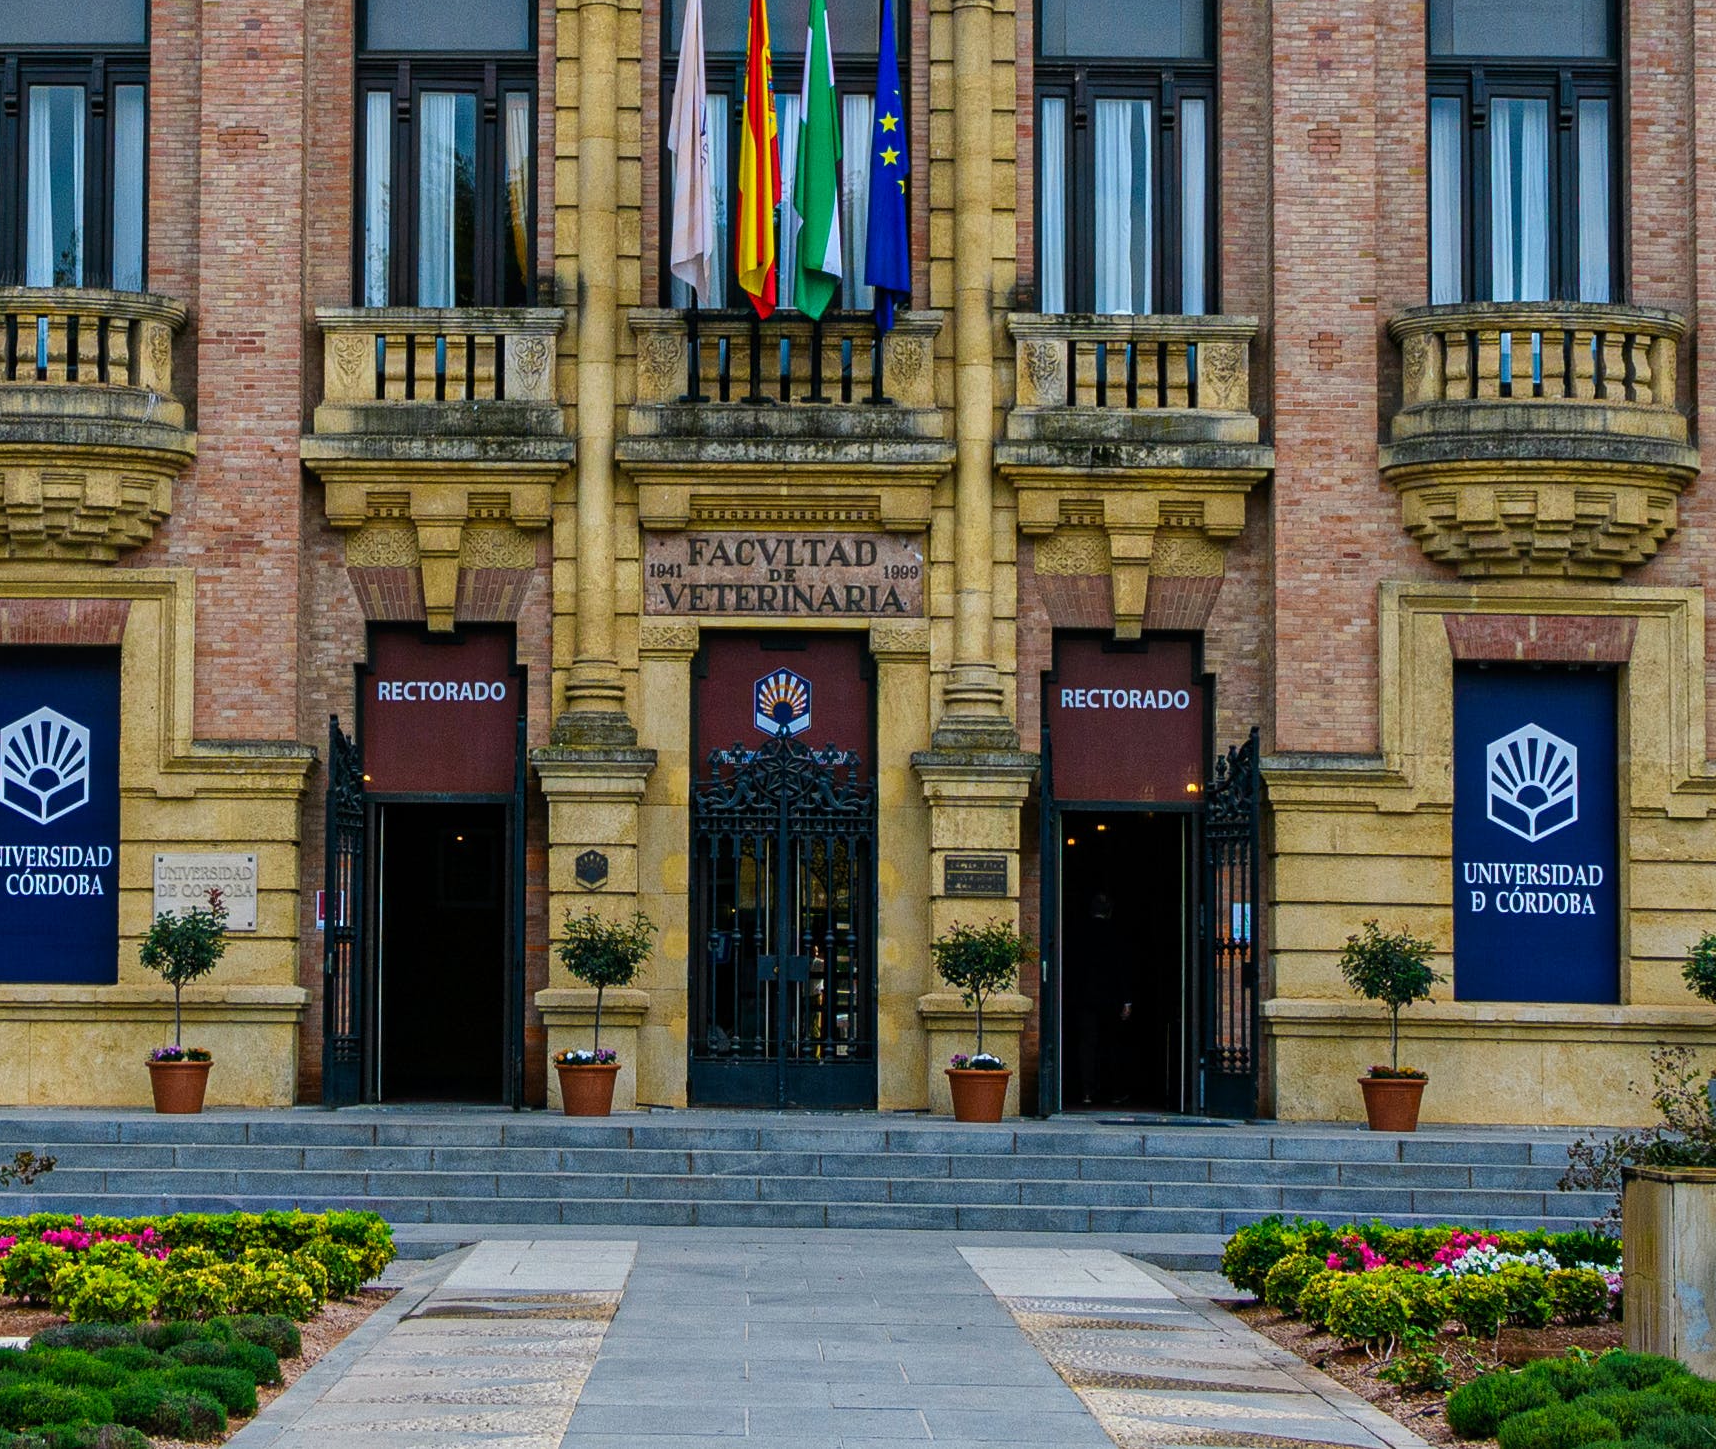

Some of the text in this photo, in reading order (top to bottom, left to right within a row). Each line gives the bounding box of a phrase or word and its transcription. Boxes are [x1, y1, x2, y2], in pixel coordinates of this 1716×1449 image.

[687, 537, 878, 567] FACVLTAD
[649, 563, 682, 578] 1941
[769, 568, 796, 583] DE
[883, 564, 919, 580] 1999
[661, 583, 906, 613] VETERINARIA
[378, 681, 506, 701] RECTORADO
[1061, 688, 1190, 709] RECTORADO
[5, 867, 105, 896] CÓRDOBA
[157, 866, 253, 881] UNIVERSIDAD
[1463, 862, 1604, 886] UNIVERSIDAD
[158, 883, 178, 898] DE
[1495, 885, 1597, 914] CÓRDOBA
